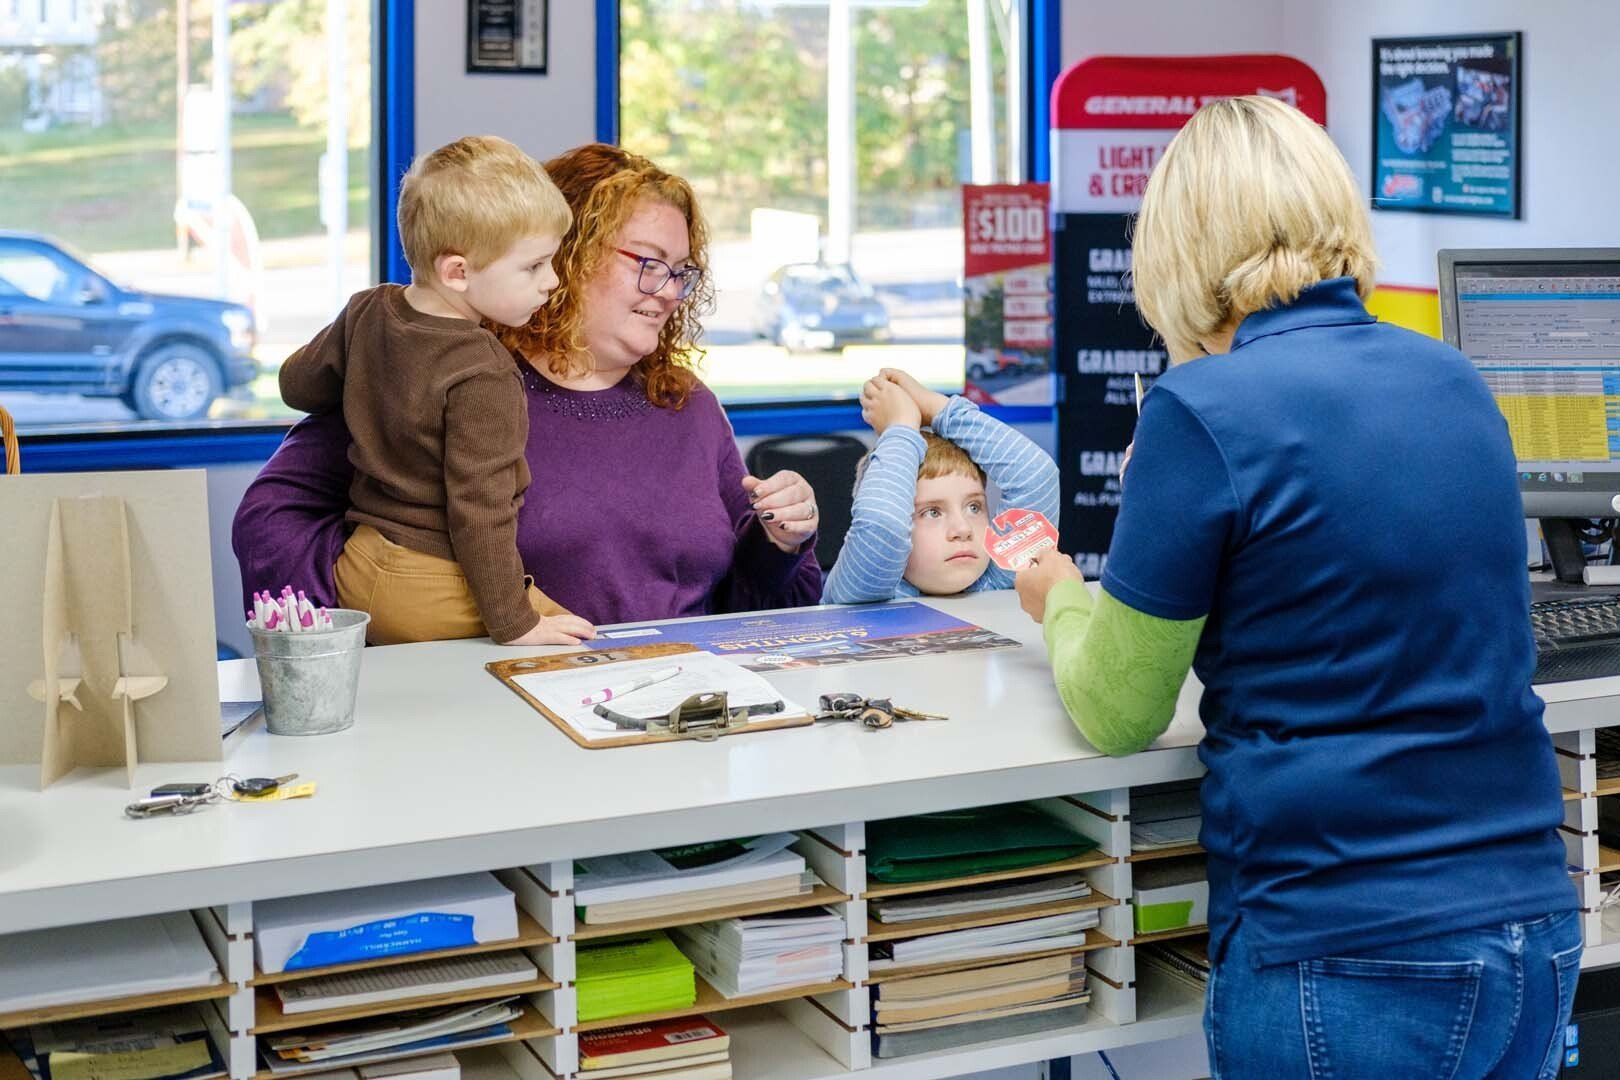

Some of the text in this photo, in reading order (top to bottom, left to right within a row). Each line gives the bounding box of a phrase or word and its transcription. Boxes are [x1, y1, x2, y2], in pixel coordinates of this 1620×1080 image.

[1084, 96, 1195, 115] GENERAL
[1099, 147, 1155, 169] LIGHT
[1089, 174, 1104, 197] &
[979, 207, 1044, 241] $100
[718, 629, 848, 651] MONTHS
